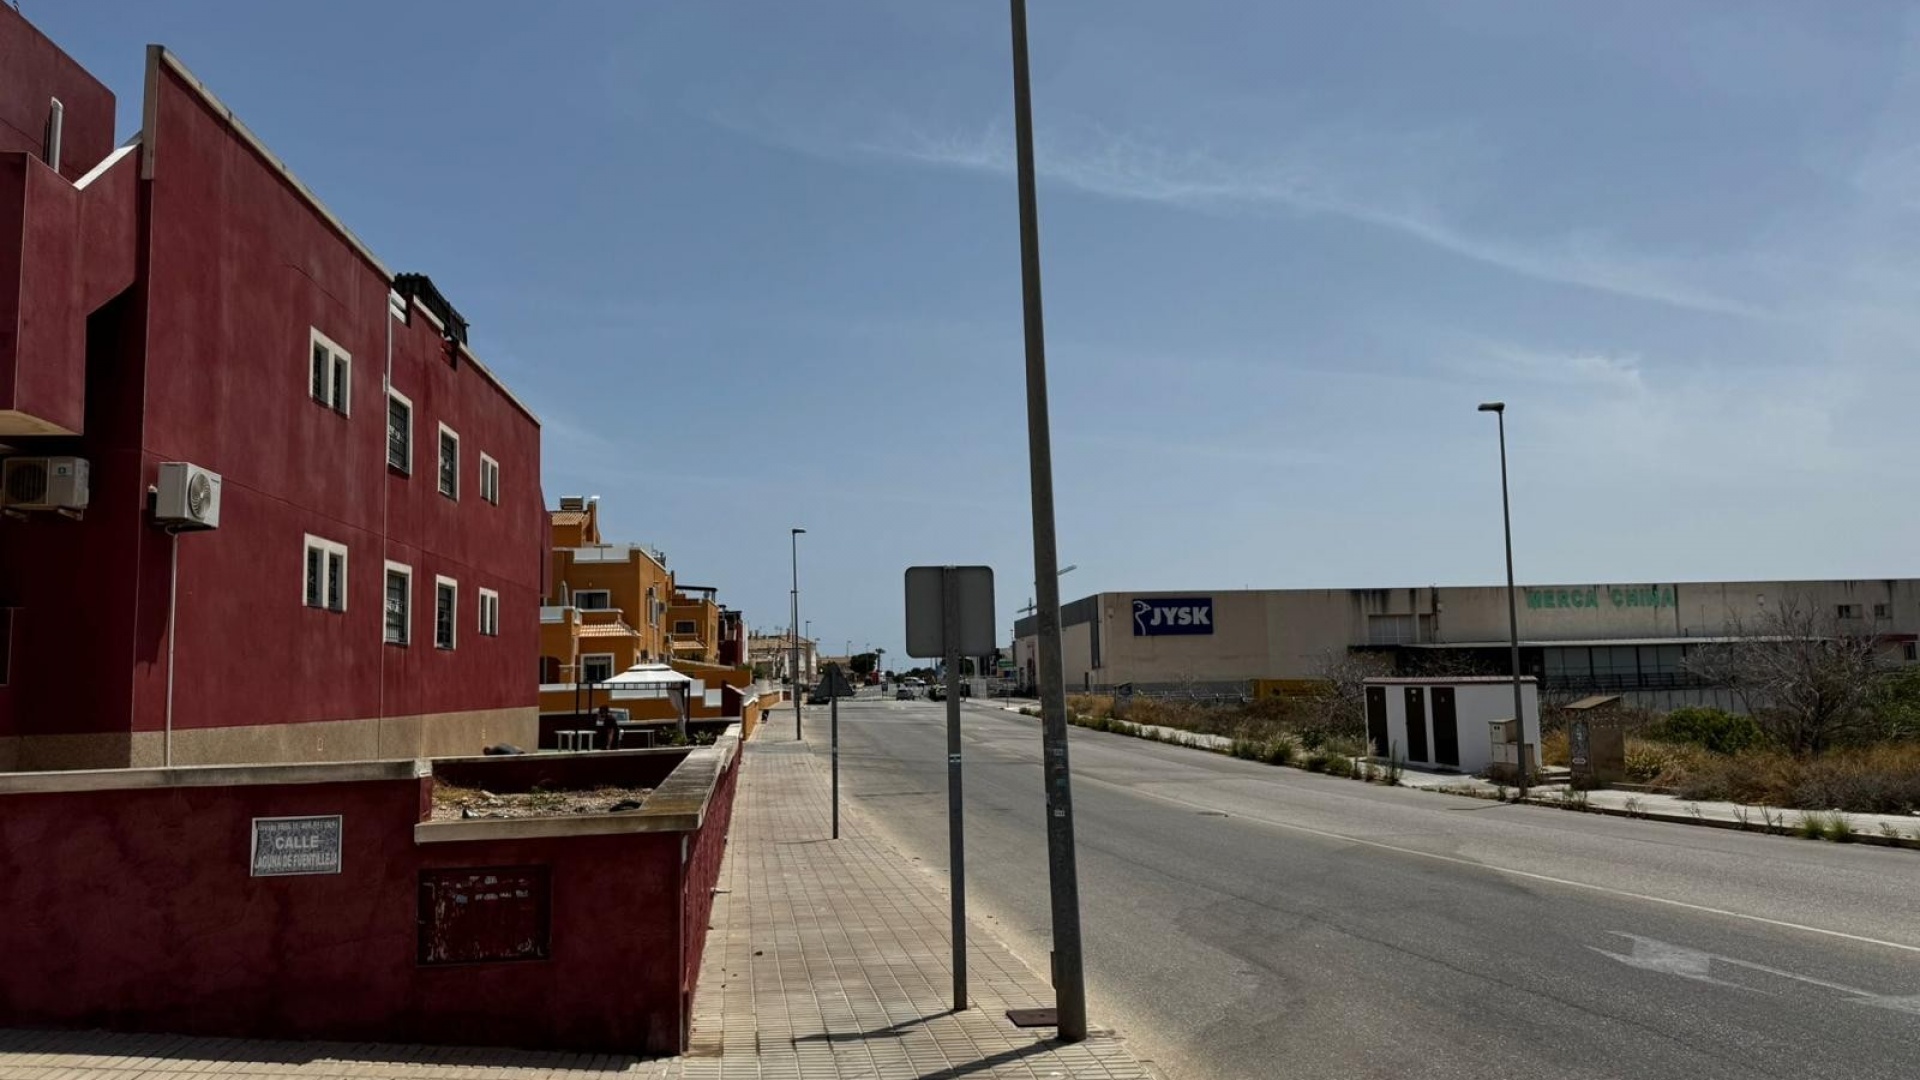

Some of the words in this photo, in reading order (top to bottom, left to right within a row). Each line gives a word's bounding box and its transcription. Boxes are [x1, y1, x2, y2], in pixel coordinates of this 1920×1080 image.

[1526, 589, 1599, 609] MERCA
[1150, 606, 1210, 626] JYSK
[275, 835, 319, 850] CALLE
